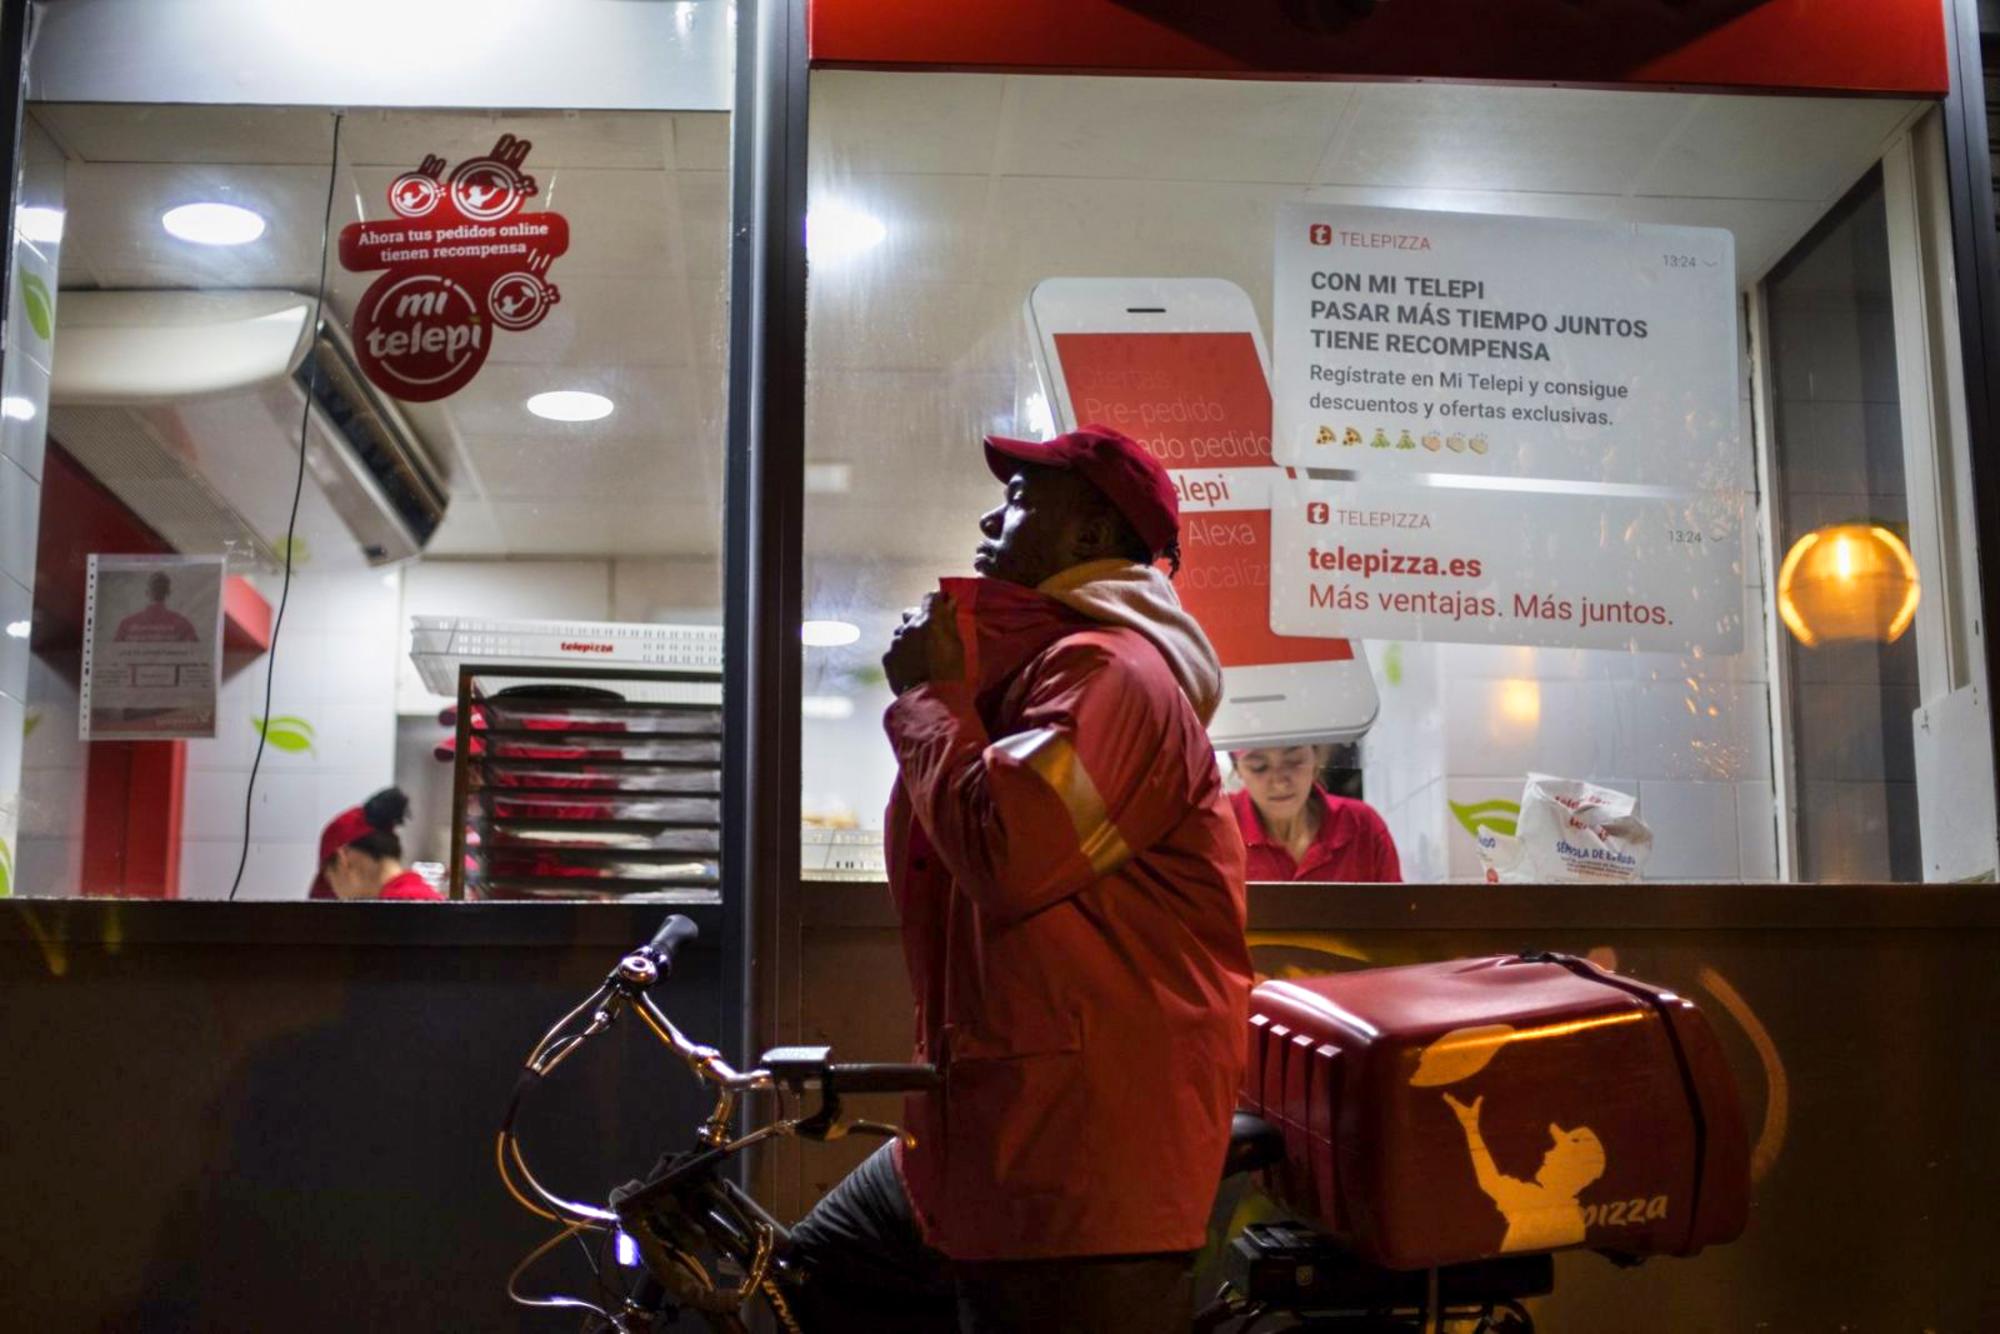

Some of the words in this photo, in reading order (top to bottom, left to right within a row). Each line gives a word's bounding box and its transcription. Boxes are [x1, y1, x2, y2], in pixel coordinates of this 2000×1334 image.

[358, 229, 404, 246] Ahora
[408, 228, 432, 241] tus
[436, 224, 496, 245] pedidos
[500, 223, 548, 236] online
[1339, 230, 1431, 251] TELEPIZZA
[381, 246, 429, 263] tienen
[433, 243, 527, 259] recompensa
[1662, 254, 1697, 269] 13:24
[395, 278, 451, 318] mi
[1310, 271, 1362, 293] CON
[1368, 274, 1397, 294] MI
[1405, 276, 1485, 299] TELEPI
[1310, 301, 1390, 323] PASAR
[1398, 301, 1451, 327] MÁS
[1456, 308, 1548, 332] TIEMPO
[1553, 315, 1648, 338] JUNTOS
[366, 316, 481, 362] telepi
[1310, 329, 1379, 352] TIENE
[1385, 333, 1551, 362] RECOMPENSA
[1310, 364, 1406, 387] Regístrate
[1411, 372, 1434, 387] en
[1439, 371, 1463, 388] Mi
[1469, 374, 1524, 394] Telepi
[1529, 379, 1540, 397] y
[1544, 378, 1629, 400] consigue
[1086, 395, 1224, 427] Pre-pedido
[1309, 392, 1419, 416] descuentos
[1423, 400, 1434, 419] y
[1439, 400, 1506, 420] ofertas
[1511, 404, 1614, 426] exclusivas.
[1188, 518, 1256, 547] Alexa
[1337, 510, 1431, 529] TELEPIZZA
[1668, 530, 1702, 544] 13:24
[1308, 546, 1482, 578] telepizza.es
[1309, 583, 1369, 611] Más
[1378, 590, 1503, 621] ventajas.
[1514, 594, 1572, 620] Más
[1579, 598, 1674, 628] juntos.
